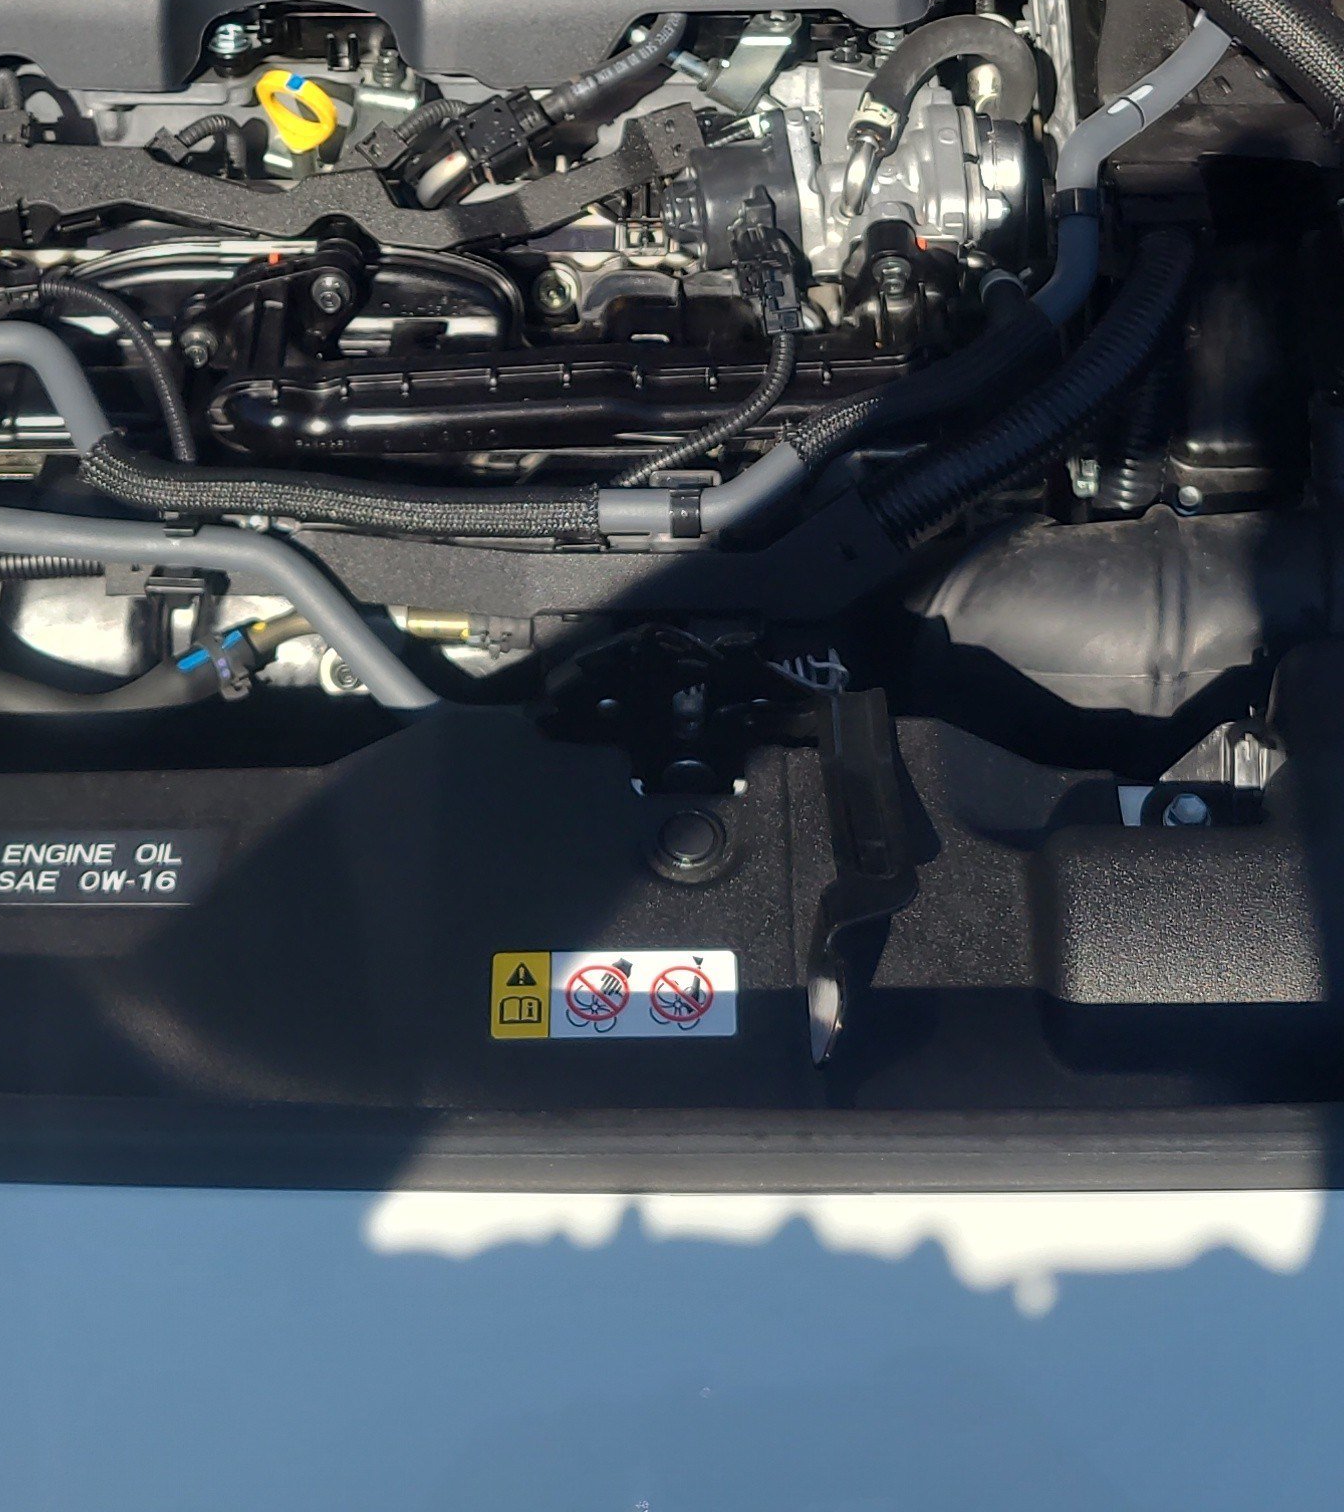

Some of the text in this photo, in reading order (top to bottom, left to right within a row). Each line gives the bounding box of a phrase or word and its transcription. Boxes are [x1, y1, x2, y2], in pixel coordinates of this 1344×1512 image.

[0, 842, 183, 865] ENGINE OIL
[78, 869, 178, 893] 0W-16
